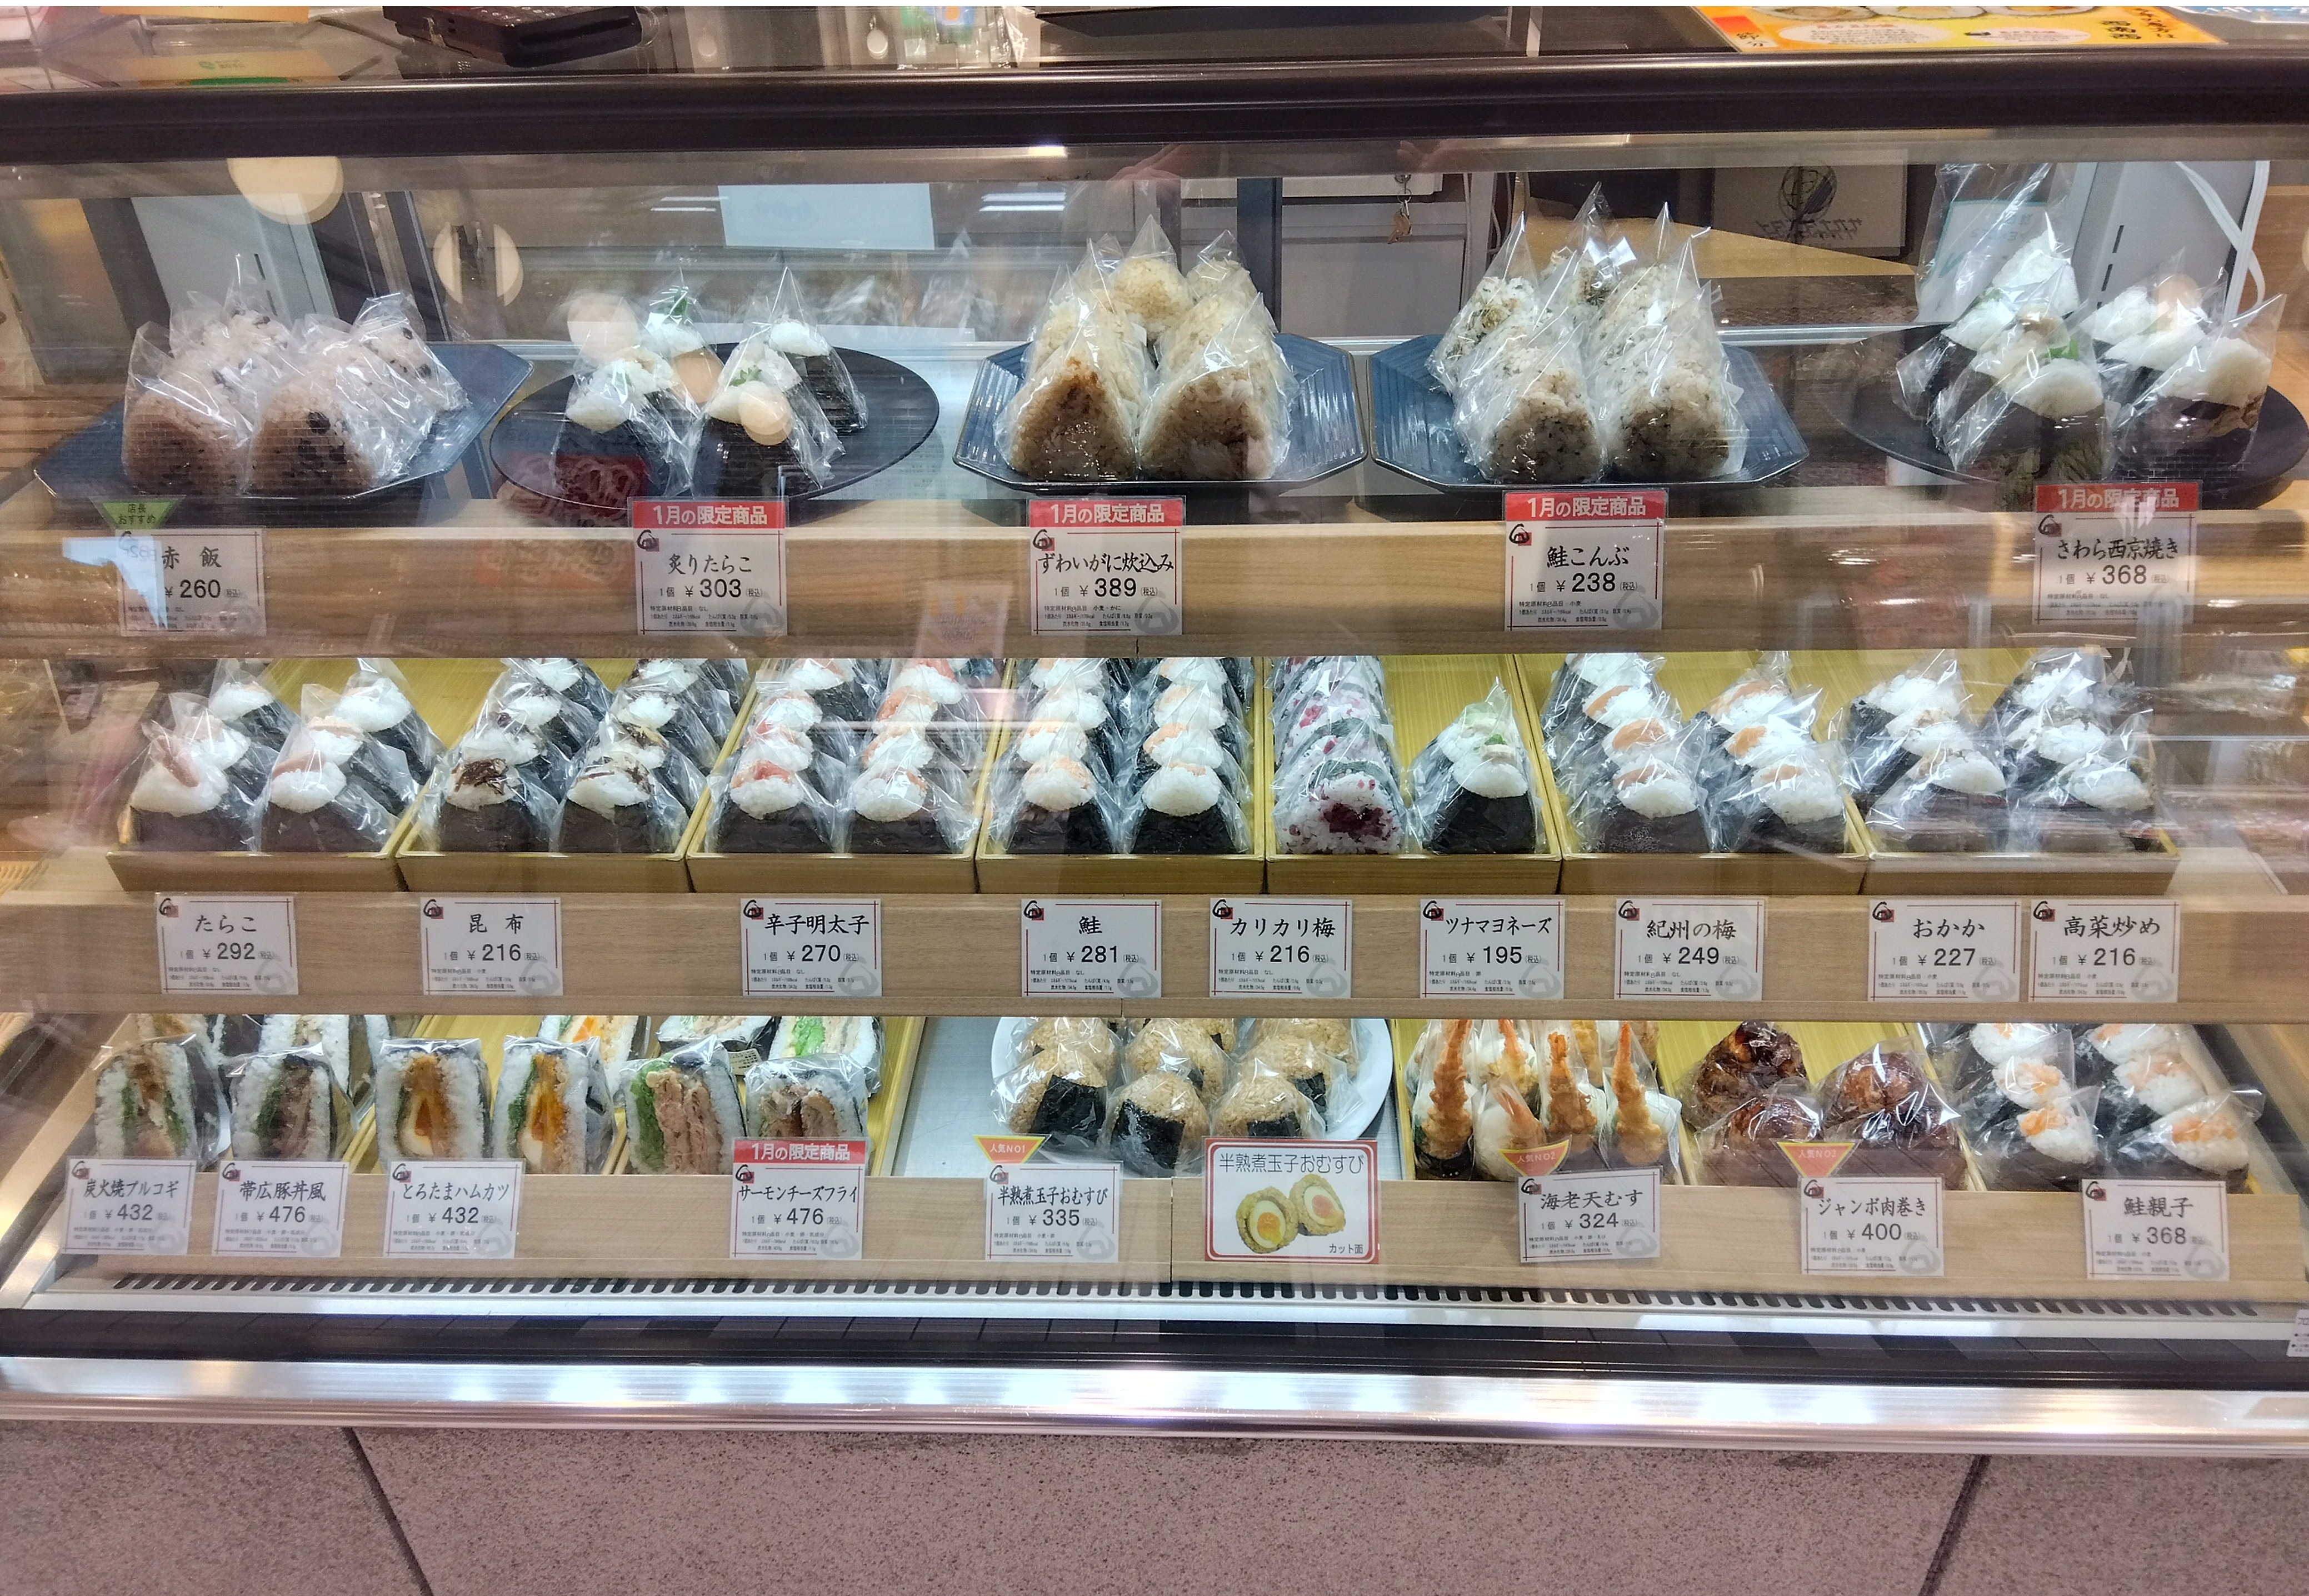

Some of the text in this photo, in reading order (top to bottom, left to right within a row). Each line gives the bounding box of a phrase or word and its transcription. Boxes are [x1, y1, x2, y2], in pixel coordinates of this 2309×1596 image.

[1528, 497, 1646, 517] 1月の限定商品
[2058, 488, 2179, 508] 1月の限定商品
[128, 504, 146, 513] 店長
[653, 506, 767, 525] 1月の限定商品
[1051, 504, 1164, 524] 1月の限定商品
[118, 514, 156, 524] おすすめ
[1547, 546, 1629, 568] 鮭こんぶ
[2058, 537, 2178, 559] さわら西京焼き
[668, 553, 751, 575] 炙りたらこ
[1038, 552, 1174, 574] ずわいがに炊込み
[195, 915, 257, 933] たらこ
[469, 913, 523, 934] 昆布
[765, 913, 869, 935] 辛子明太子
[1079, 915, 1102, 934] 鮭
[1231, 918, 1336, 938] カリカリ梅
[1446, 916, 1552, 935] ツナマヨネーズ
[1647, 919, 1736, 939] 紀州の梅
[1913, 919, 1985, 938] おかか
[2064, 915, 2160, 939] 高菜炒め
[752, 1144, 850, 1160] 1月の限定商品
[1220, 1153, 1365, 1174] 半熟煮玉子おむすび
[240, 1180, 326, 1202] 帯広豚丼風
[403, 1182, 509, 1201] とろたまハムカツ
[739, 1185, 857, 1203] サーモンチーズフライ
[998, 1185, 1108, 1206] 半熟煮玉子おむすび
[1541, 1190, 1643, 1210] 海老天むす
[1820, 1197, 1926, 1217] ジャンボ肉巻き
[2124, 1197, 2193, 1218] 鮭親子
[1329, 1244, 1363, 1254] カット面
